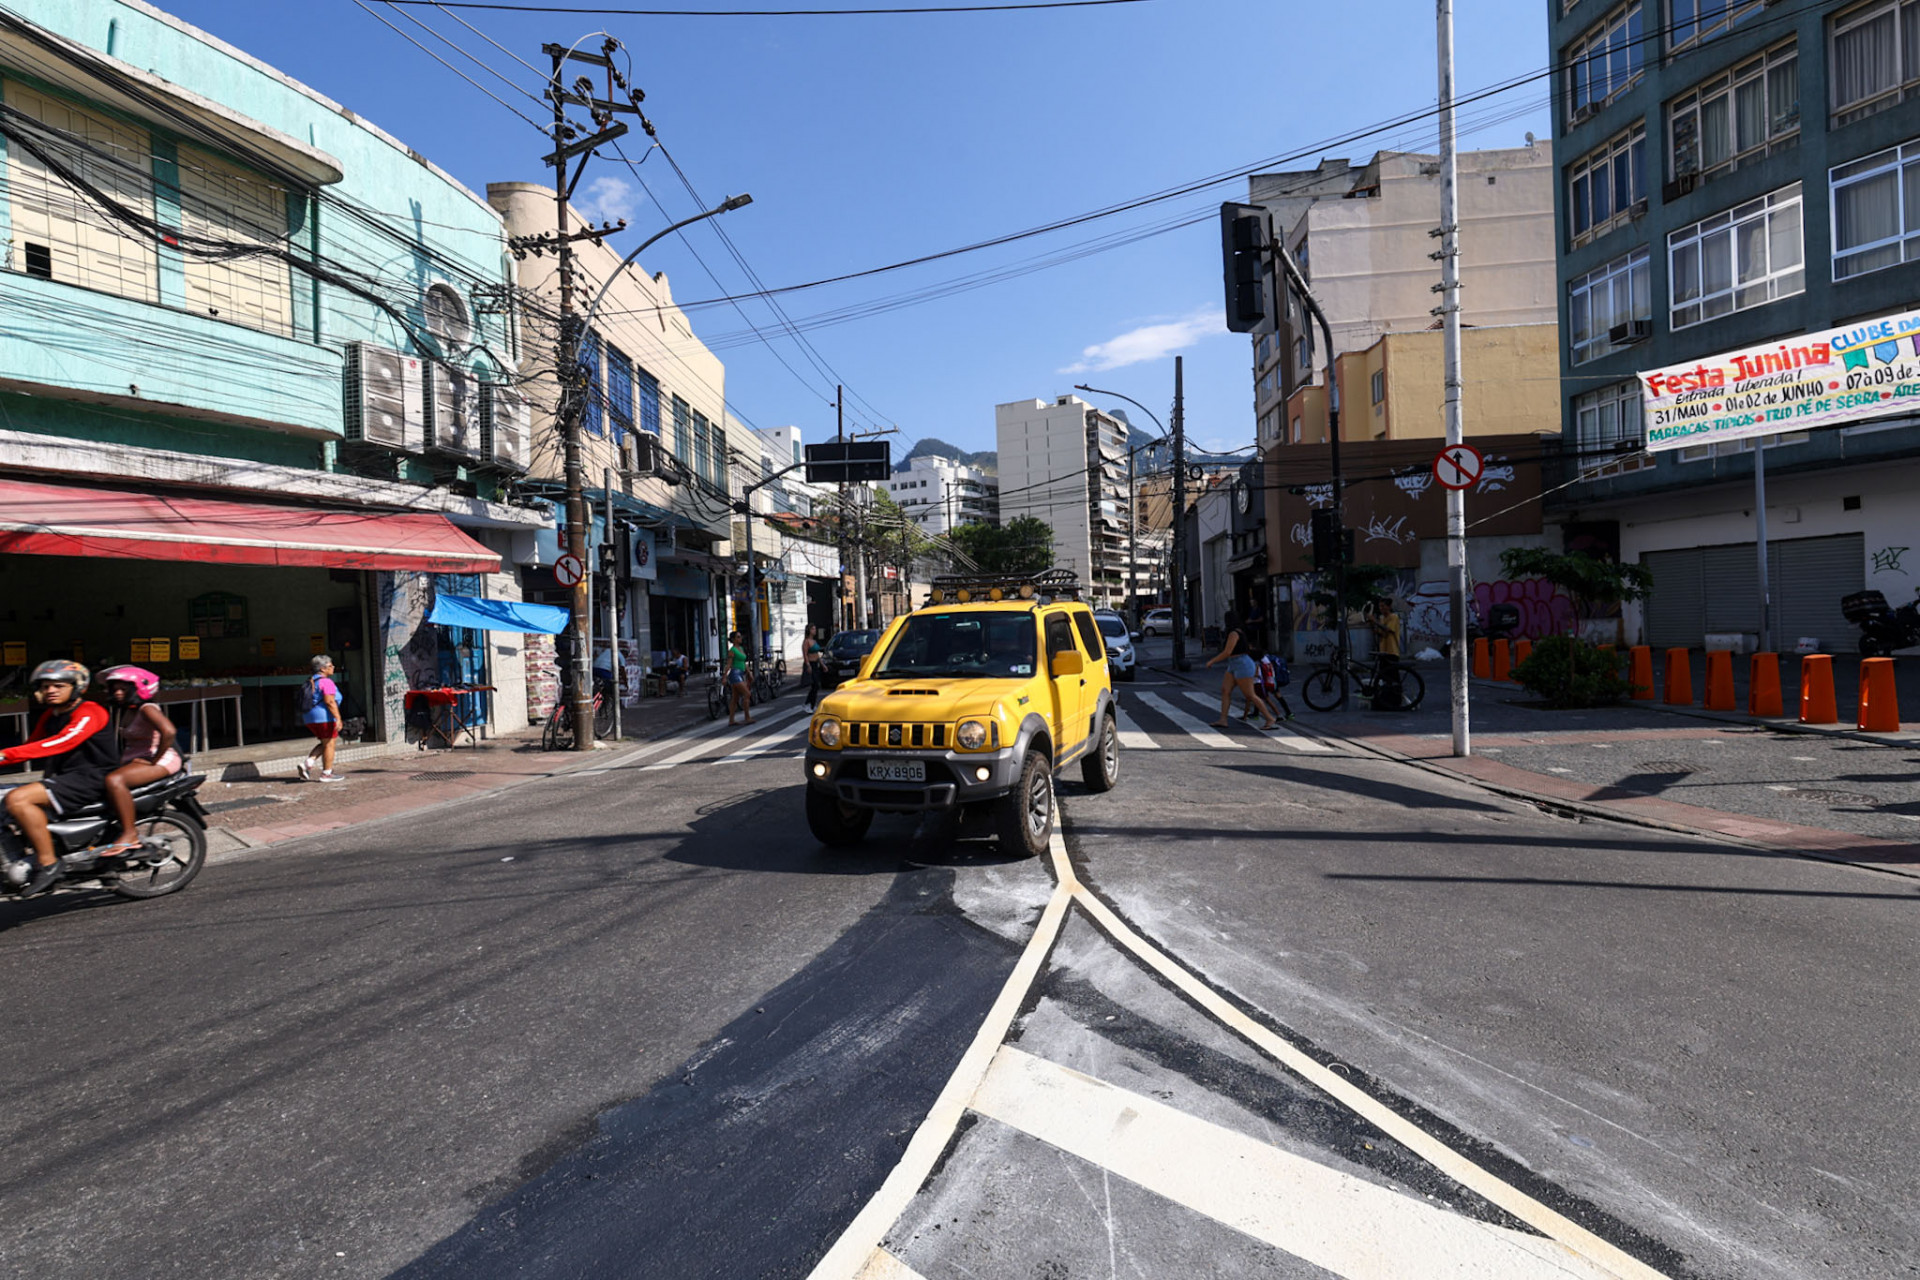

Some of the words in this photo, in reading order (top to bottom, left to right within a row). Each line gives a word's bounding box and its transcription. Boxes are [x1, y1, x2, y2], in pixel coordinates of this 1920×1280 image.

[1831, 321, 1894, 350] CLUBE
[1646, 364, 1724, 397] Festa
[1729, 343, 1830, 382] Junina
[1655, 402, 1708, 424] 31/MAIO
[1763, 391, 1777, 405] de
[1781, 380, 1824, 403] JUNHO
[1896, 363, 1913, 380] de
[1675, 387, 1725, 405] Entrada
[1649, 421, 1710, 442] BARRACAS
[1797, 398, 1813, 417] PÉ
[1816, 399, 1831, 412] DE
[1836, 390, 1880, 409] SERRA
